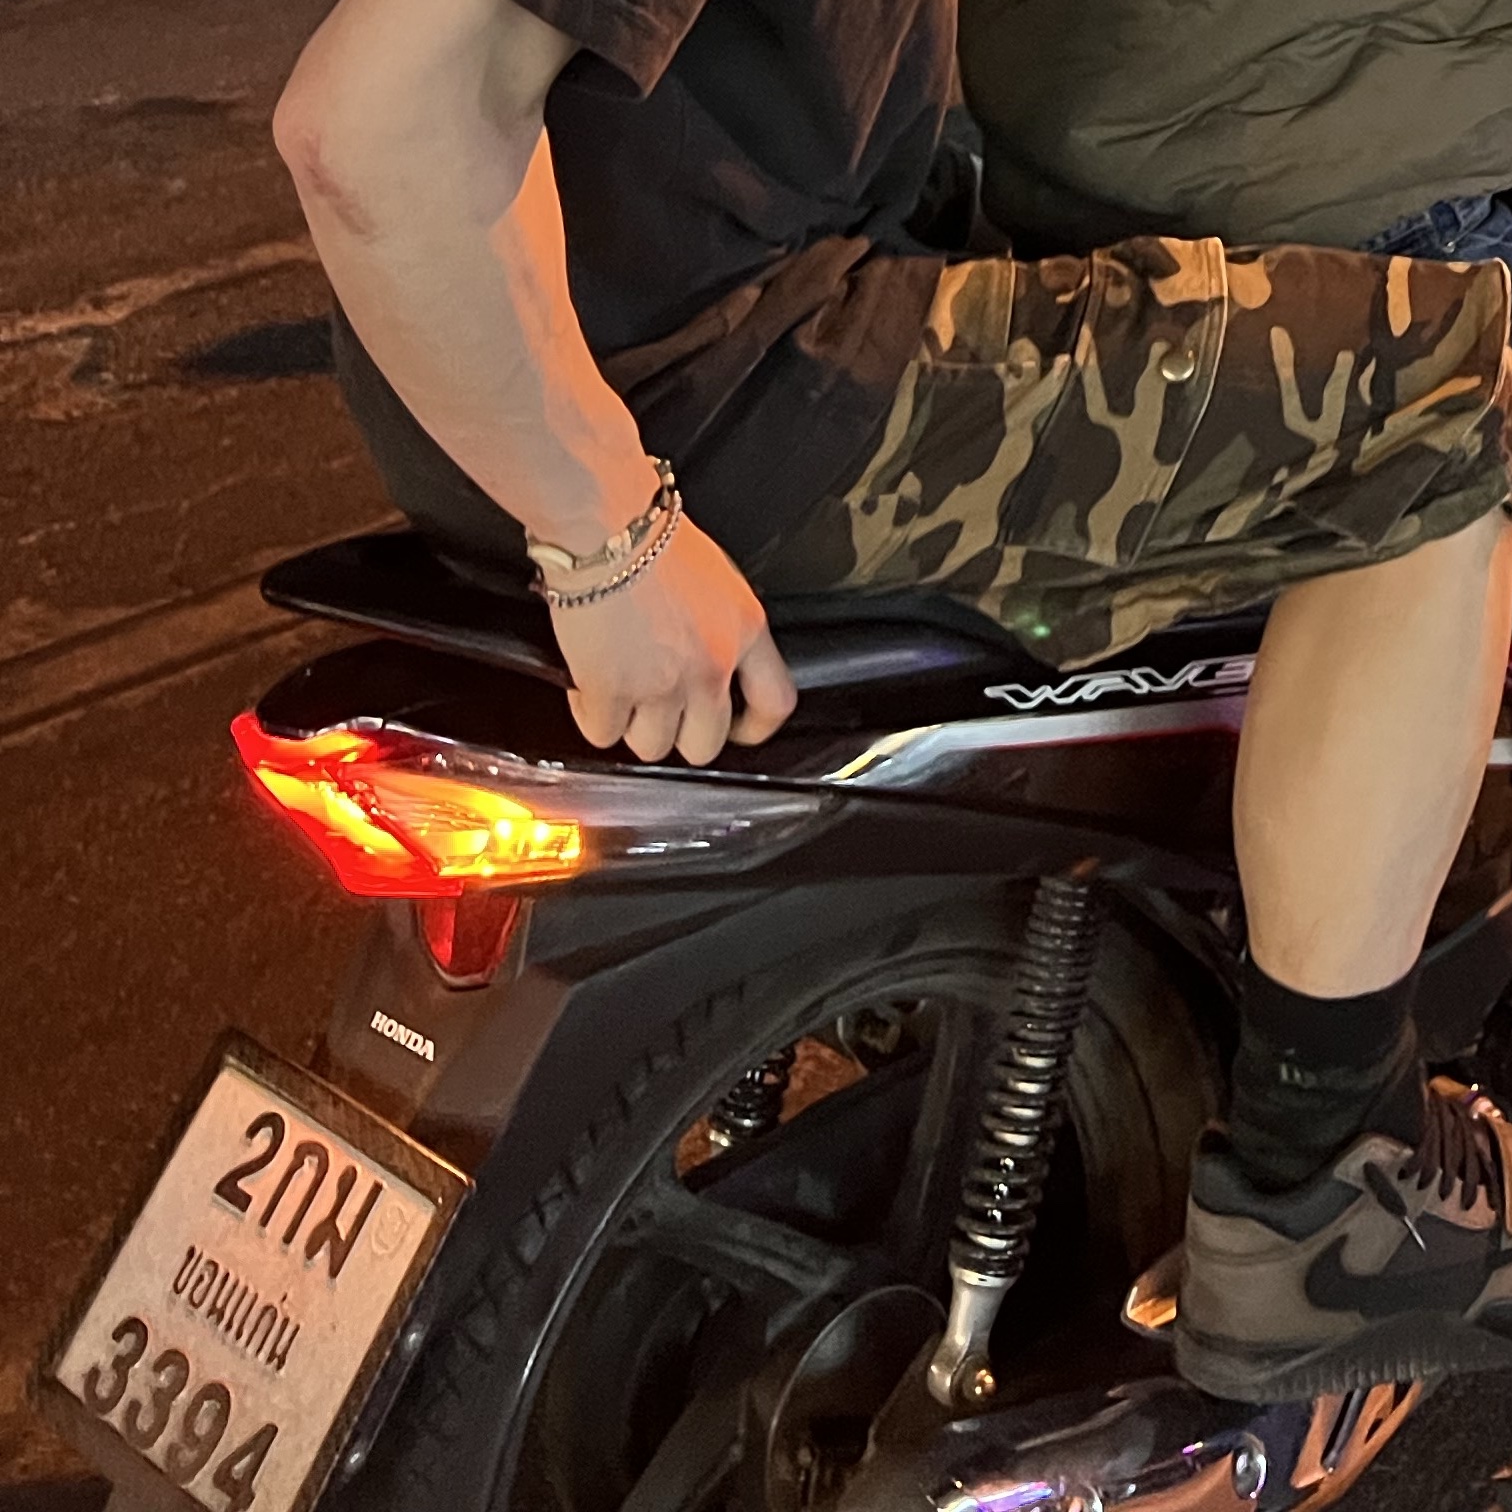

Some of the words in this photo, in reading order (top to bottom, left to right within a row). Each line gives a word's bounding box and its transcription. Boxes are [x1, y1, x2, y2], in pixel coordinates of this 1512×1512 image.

[370, 1010, 437, 1062] HONDA
[212, 1110, 384, 1280] 2กม
[171, 1244, 301, 1375] ขอนแก่น
[83, 1316, 279, 1512] 3394
